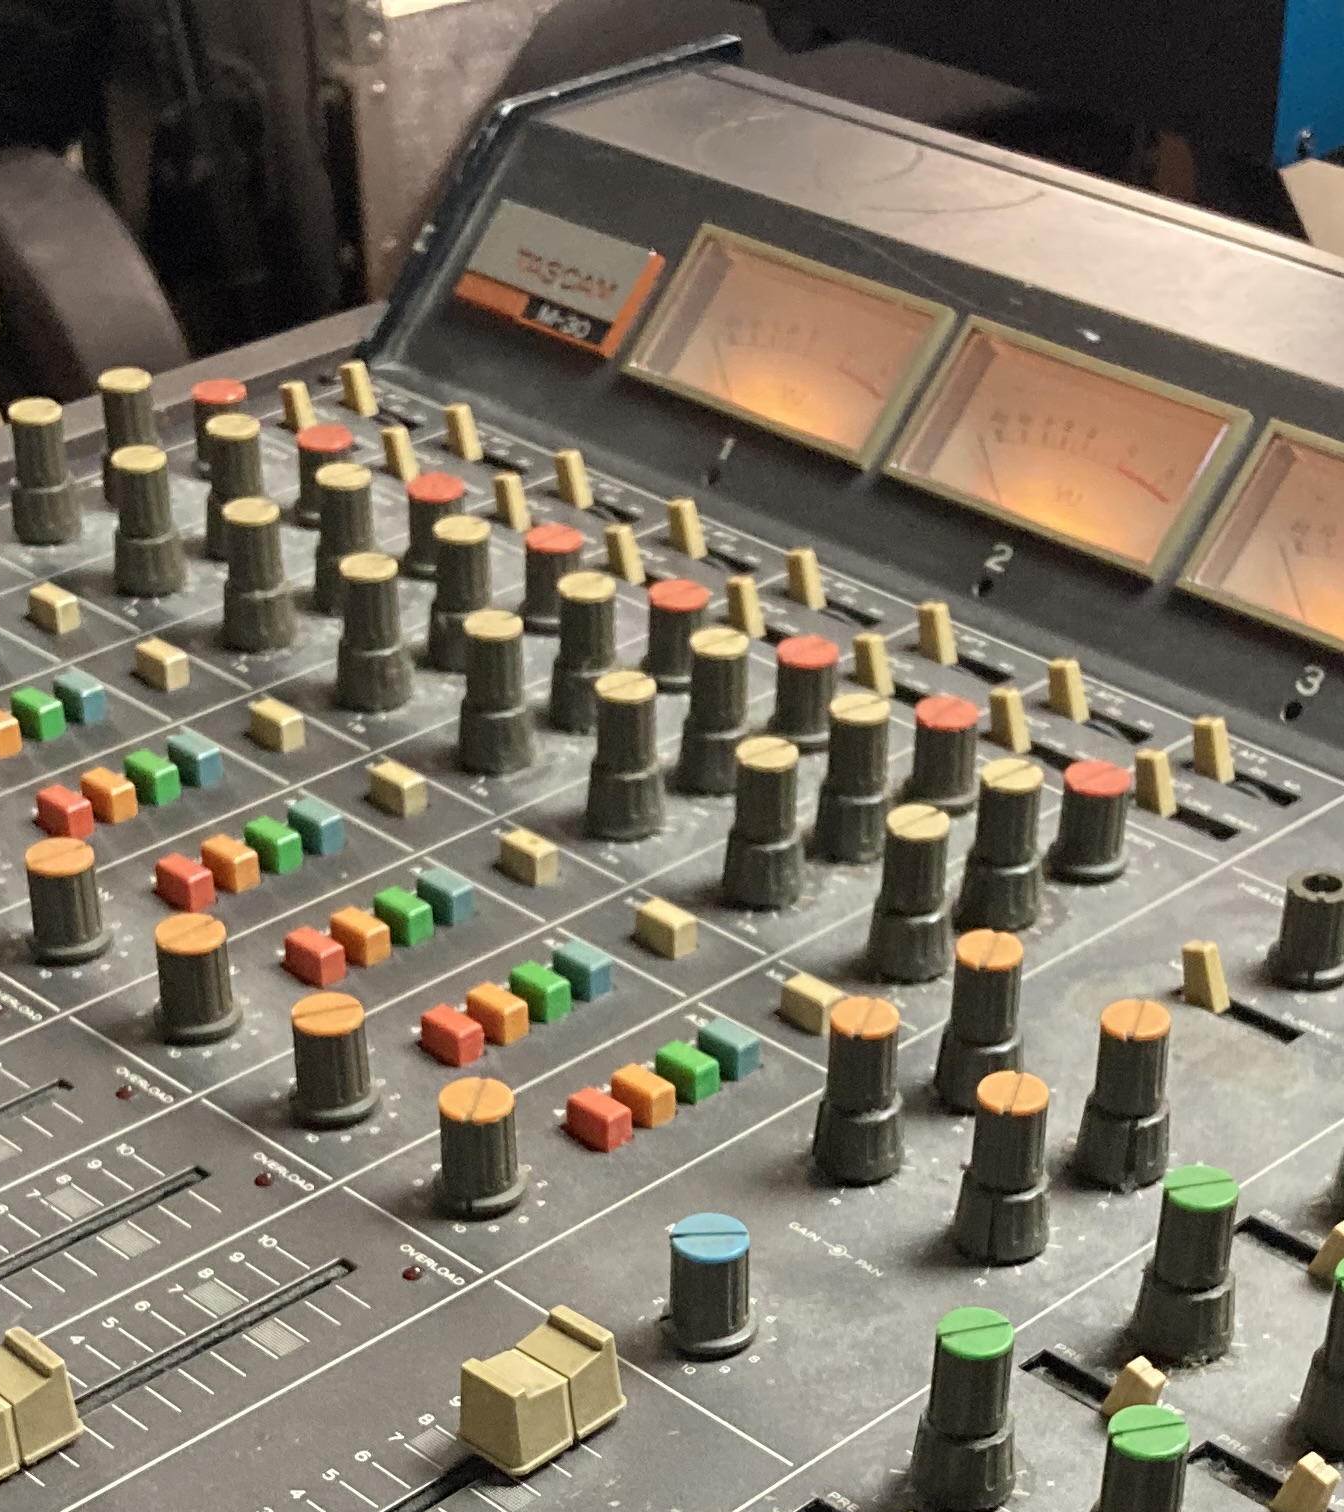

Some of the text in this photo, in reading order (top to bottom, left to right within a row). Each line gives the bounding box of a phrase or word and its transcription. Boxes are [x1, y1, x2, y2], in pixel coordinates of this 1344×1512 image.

[719, 437, 735, 461] 1
[984, 541, 1014, 573] 2
[1295, 665, 1325, 697] 3
[25, 1188, 41, 1199] 7
[56, 1174, 72, 1185] 8
[87, 1158, 103, 1170] 9
[116, 1143, 136, 1157] 10
[253, 1151, 315, 1191] OVERLOAD
[399, 1244, 466, 1286] OVERLOAD
[788, 1221, 884, 1278] GAIN PAN
[70, 1234, 278, 1345] 4 5 6 7 8 9 10
[290, 1489, 306, 1500] 4
[322, 1468, 340, 1482] 5
[354, 1450, 372, 1463] 6
[388, 1431, 404, 1443] 7
[418, 1413, 435, 1427] 8
[1216, 1434, 1253, 1455] PRE
